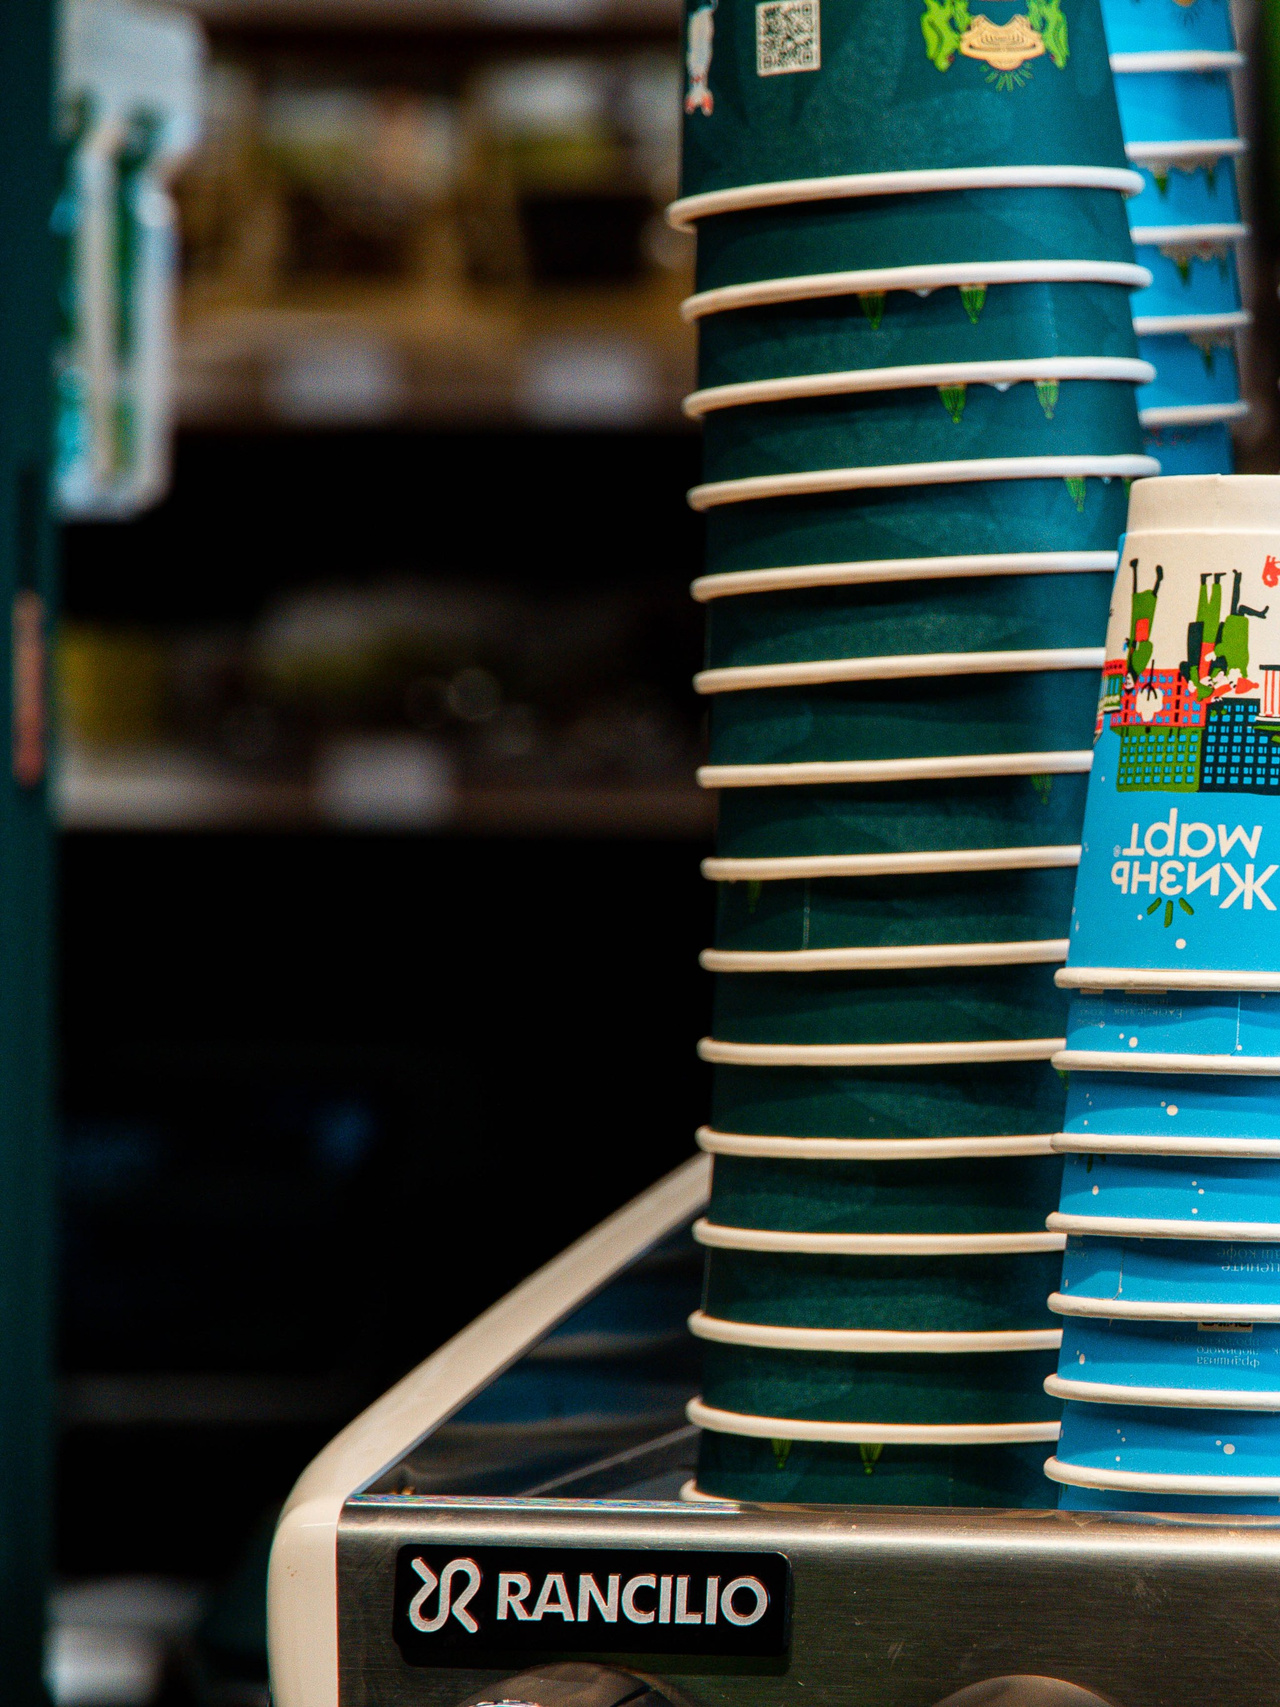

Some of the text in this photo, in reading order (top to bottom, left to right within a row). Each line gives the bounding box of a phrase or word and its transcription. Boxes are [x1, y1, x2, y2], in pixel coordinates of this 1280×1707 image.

[1121, 807, 1263, 860] март
[1110, 859, 1280, 911] Жизнь
[1216, 1243, 1256, 1261] кофе
[1196, 1346, 1260, 1357] любимого
[1196, 1356, 1261, 1369] Франшиза
[496, 1570, 771, 1627] RANCILIO
